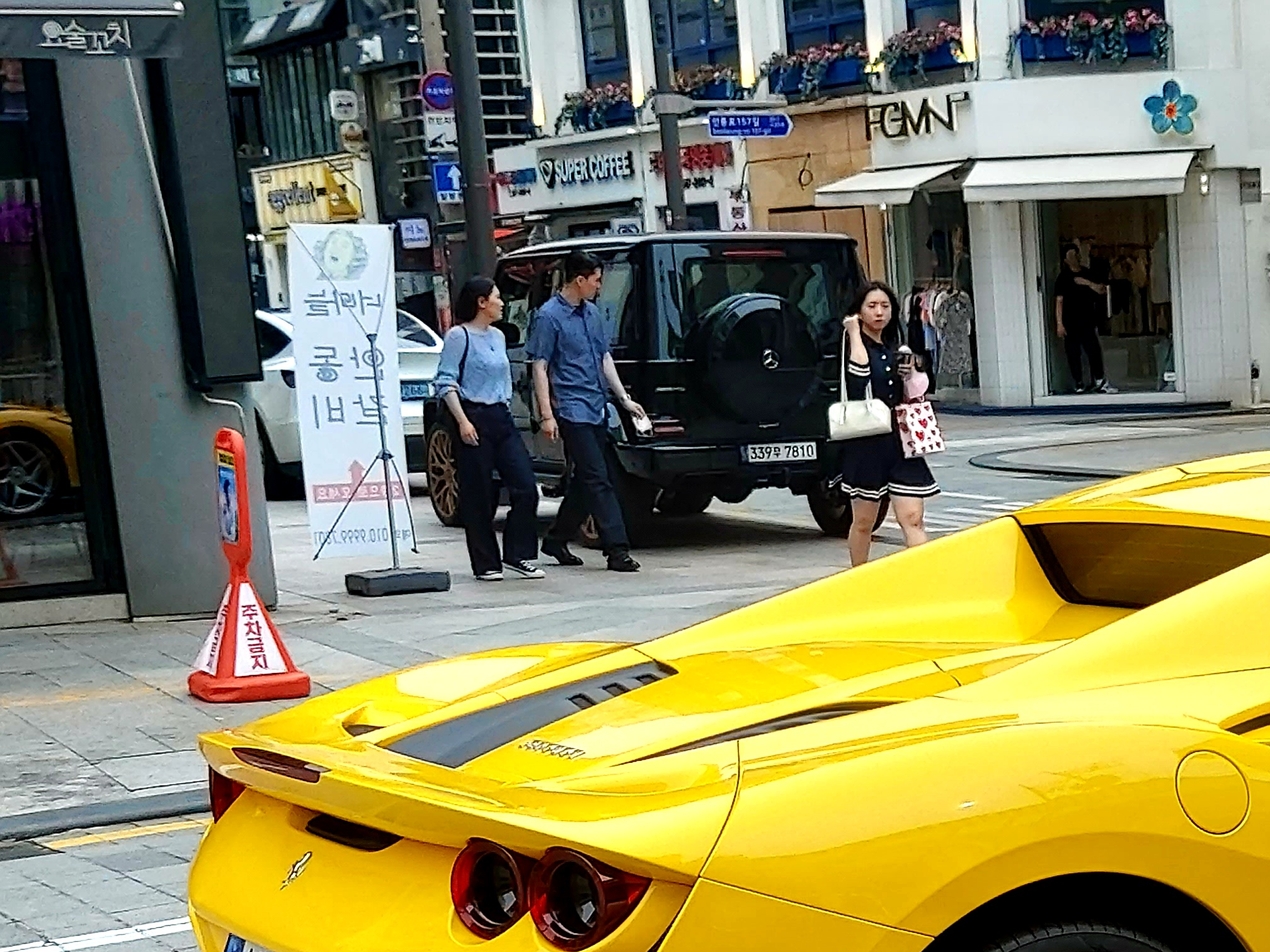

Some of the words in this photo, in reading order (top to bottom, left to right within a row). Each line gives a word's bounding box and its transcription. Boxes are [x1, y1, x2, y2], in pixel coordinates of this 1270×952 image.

[555, 157, 589, 182] SUPER
[589, 151, 632, 179] COFFEE
[784, 445, 814, 458] 7810
[241, 604, 269, 670] 주차금지
